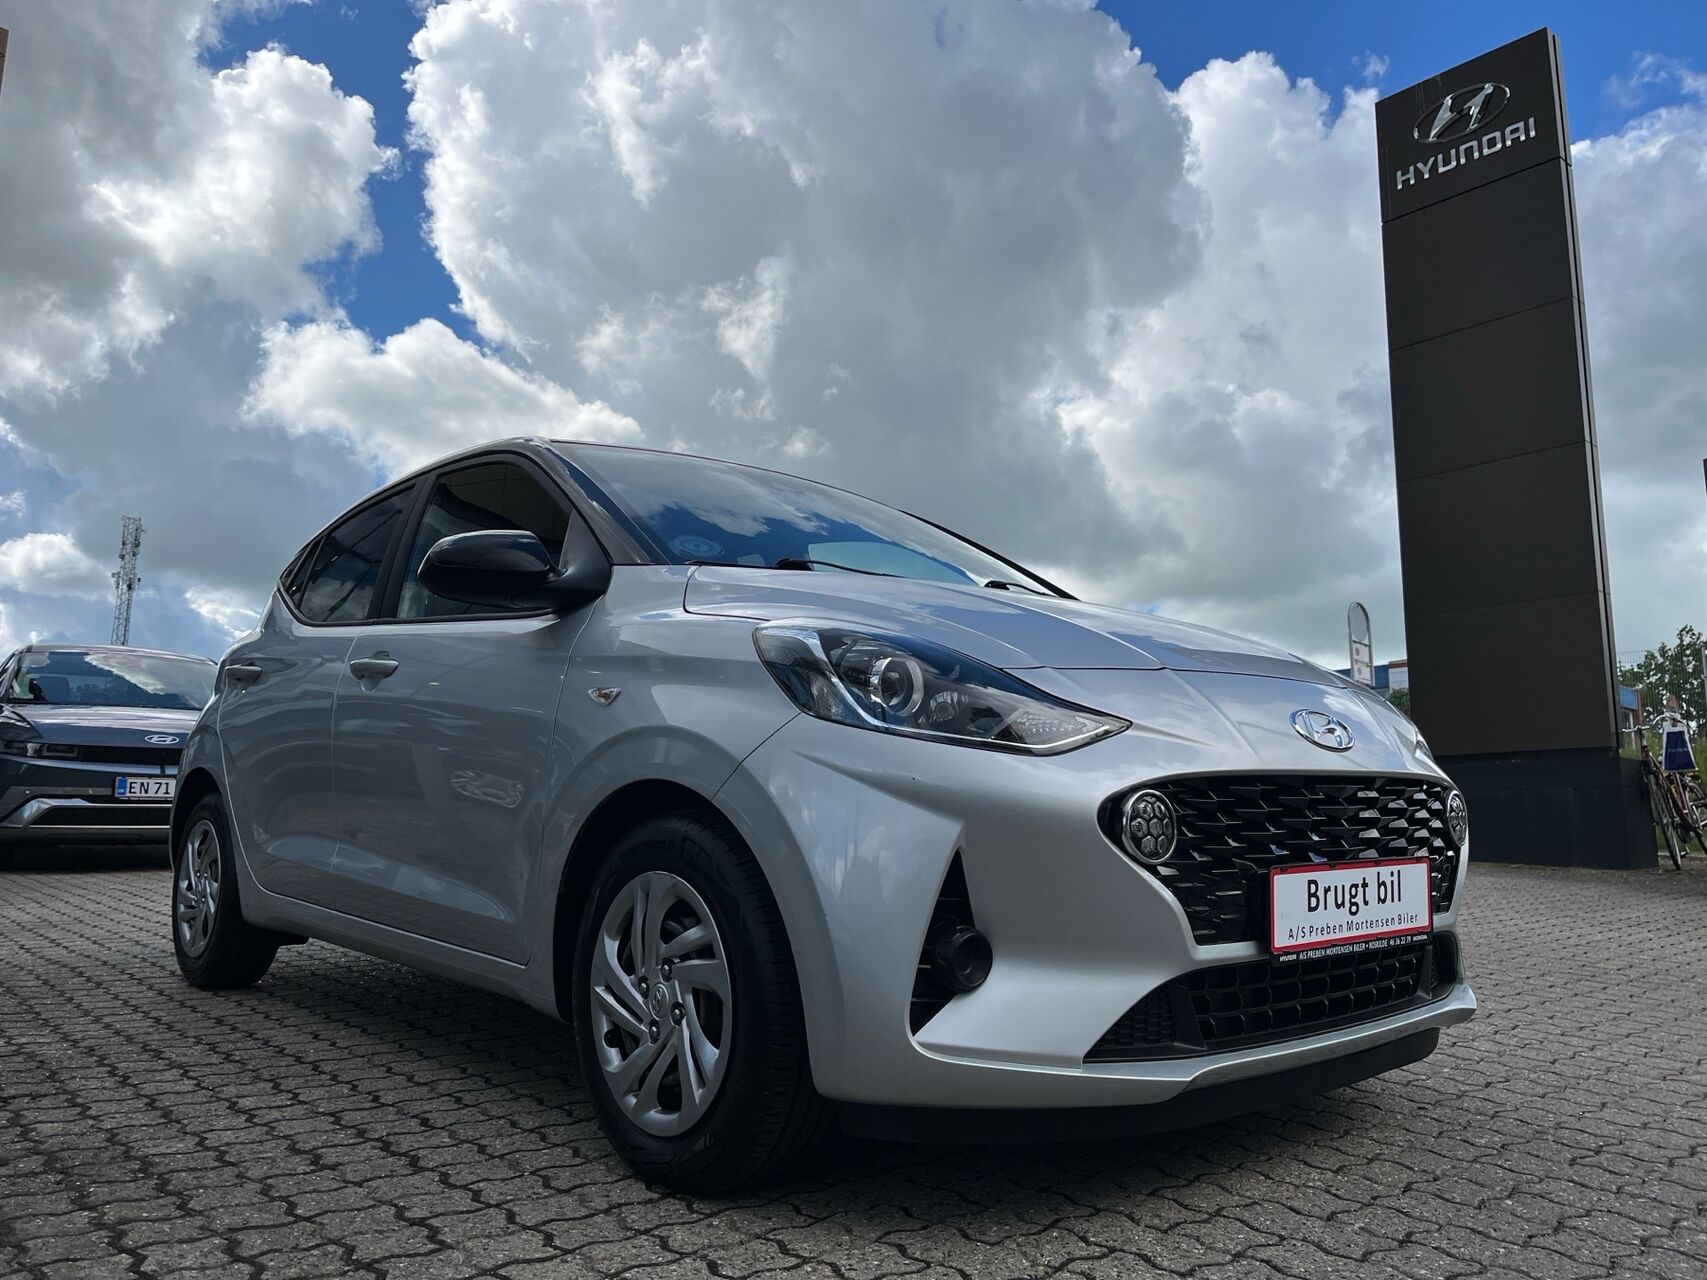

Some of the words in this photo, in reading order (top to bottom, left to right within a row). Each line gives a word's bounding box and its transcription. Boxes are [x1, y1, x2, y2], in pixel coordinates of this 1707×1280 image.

[1396, 116, 1537, 190] HYUNDAI
[128, 781, 150, 795] EN
[154, 781, 171, 795] 71
[1307, 877, 1369, 916] Brugt
[1377, 869, 1402, 905] bil
[1288, 926, 1307, 941] A/S
[1309, 922, 1344, 937] Preben
[1346, 916, 1396, 932] Mortensen
[1397, 912, 1418, 926] Biler
[1307, 948, 1326, 959] PREBEN
[1326, 944, 1353, 957] MORTENSEN
[1353, 942, 1366, 952] BILER
[1368, 939, 1388, 949] ROSKILDE
